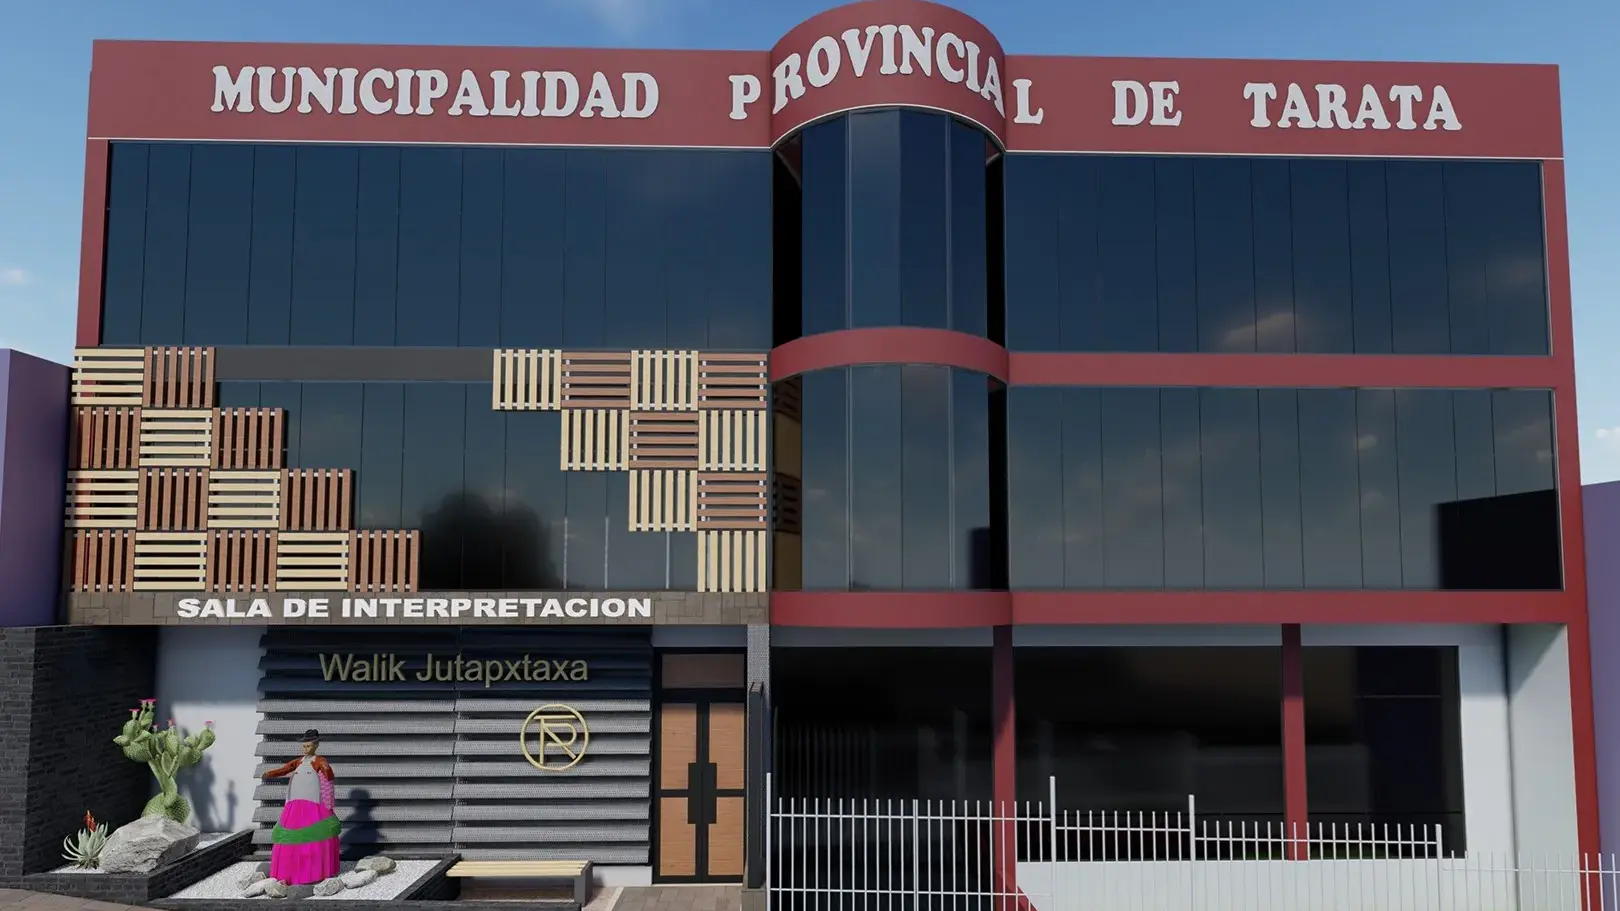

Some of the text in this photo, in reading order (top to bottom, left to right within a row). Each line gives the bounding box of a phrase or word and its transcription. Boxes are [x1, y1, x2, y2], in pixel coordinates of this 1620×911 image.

[210, 65, 659, 119] MUNICIPALIDAD
[1111, 80, 1182, 127] DE
[1243, 82, 1463, 131] TARATA
[177, 598, 652, 618] SALA DE INTERPRETACION
[319, 652, 589, 688] Walik Jutapxtaxa
